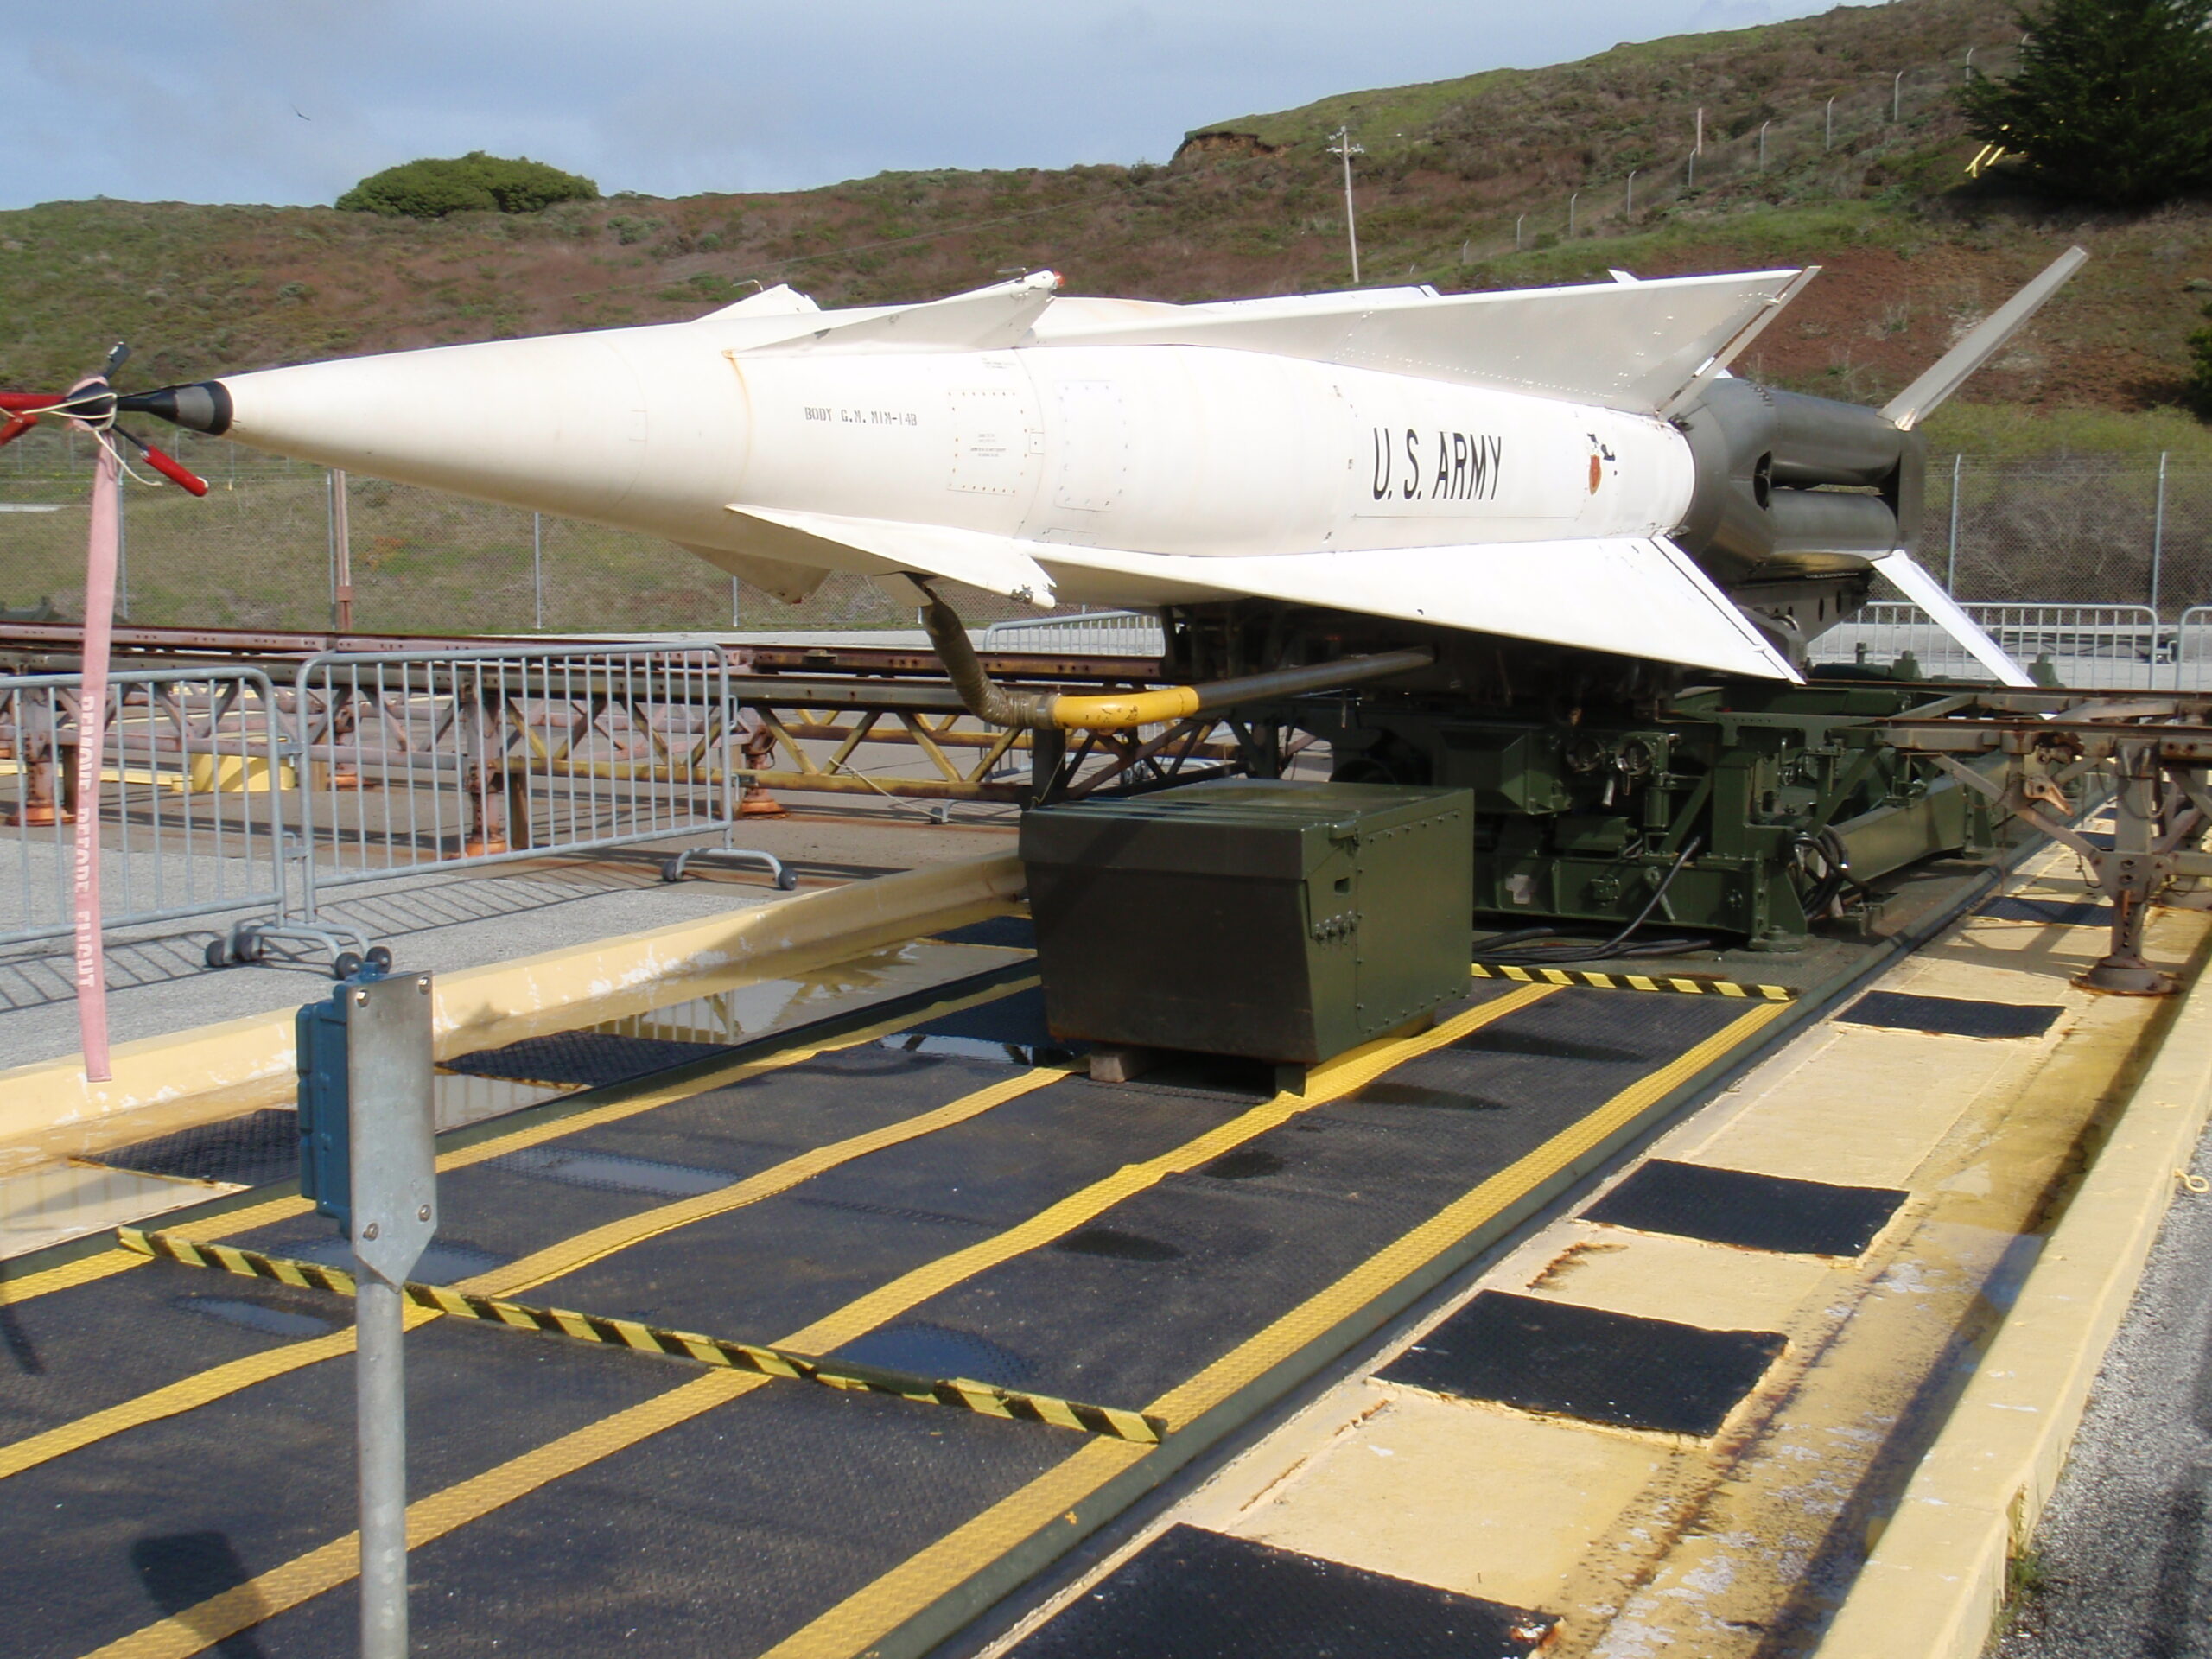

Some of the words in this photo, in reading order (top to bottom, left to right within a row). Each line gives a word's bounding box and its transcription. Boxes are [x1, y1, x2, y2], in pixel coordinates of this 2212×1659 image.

[804, 407, 832, 422] BODY
[871, 410, 918, 426] MIM-14B
[1432, 430, 1502, 501] ARMY
